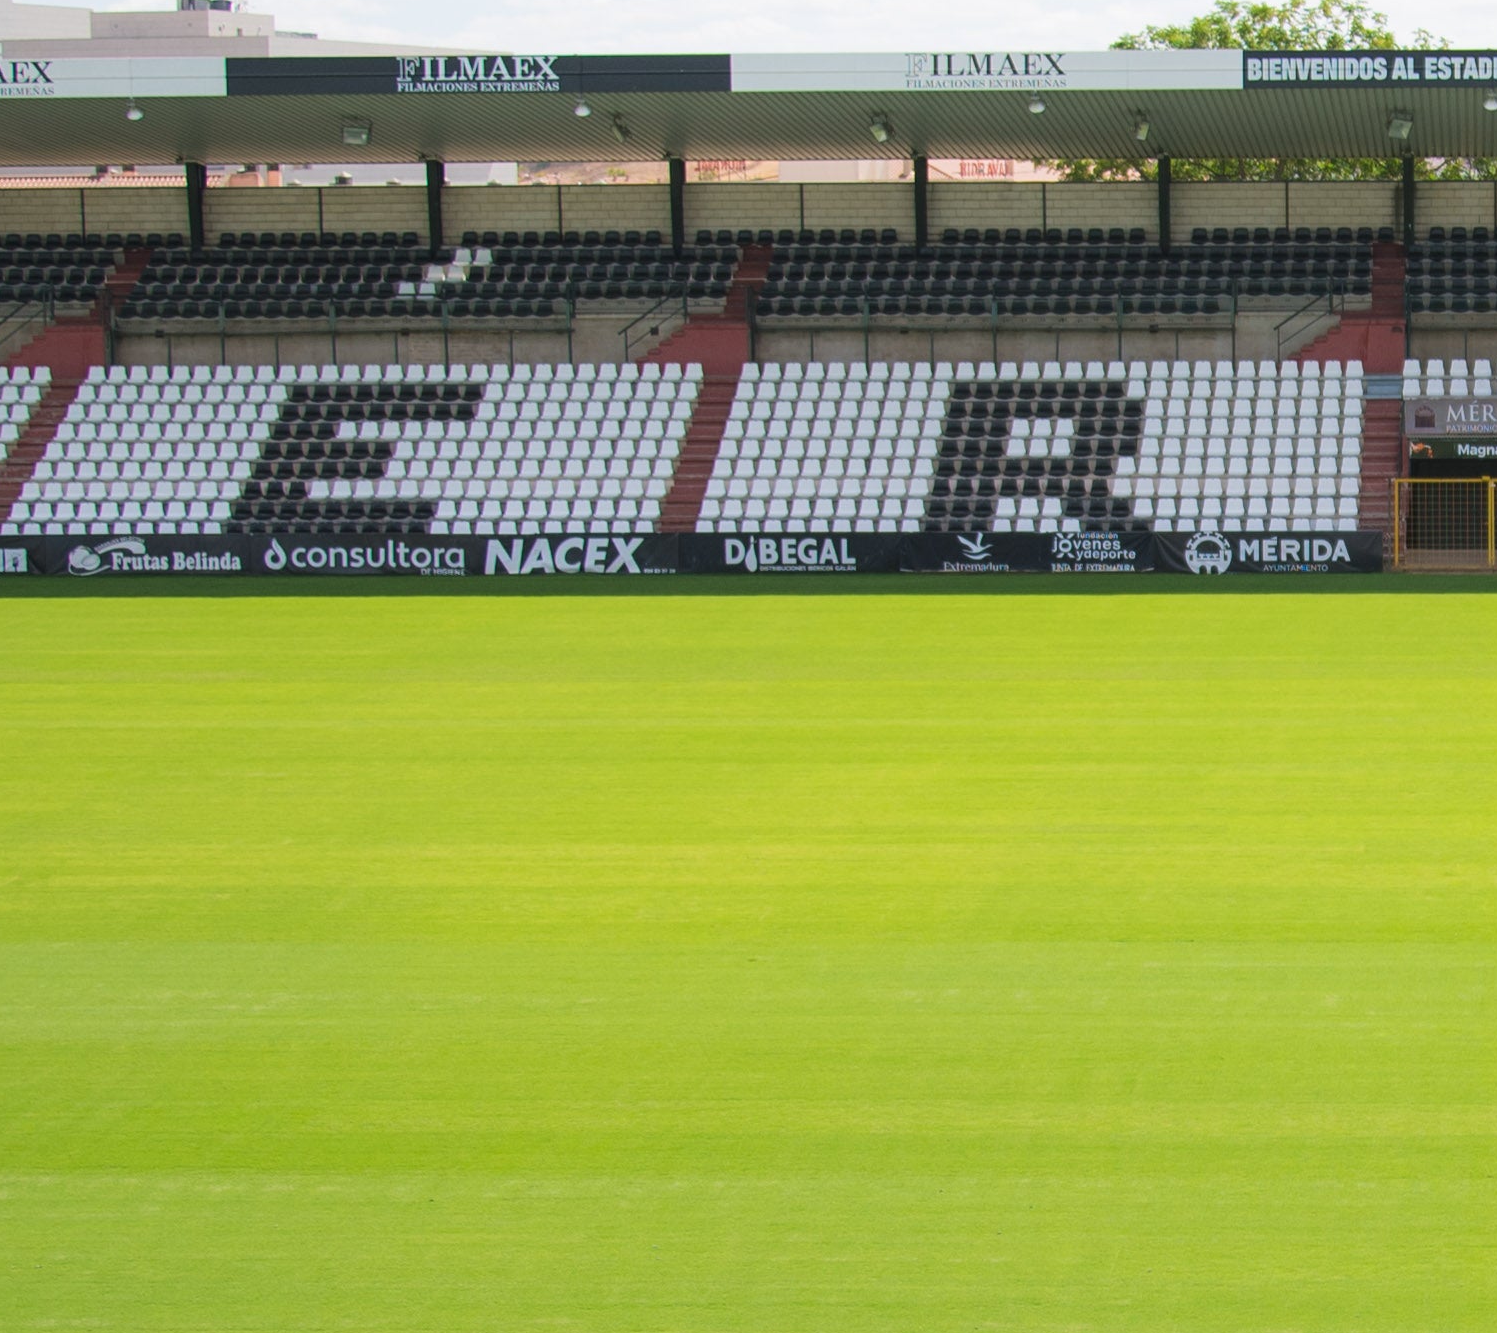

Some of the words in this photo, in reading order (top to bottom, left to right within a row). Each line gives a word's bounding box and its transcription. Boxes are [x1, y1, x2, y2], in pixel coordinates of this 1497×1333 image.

[397, 56, 559, 81] FILMAEX
[904, 53, 1066, 78] FILMAEX
[1248, 56, 1387, 81] BIENVENIDOS
[1392, 57, 1420, 80] AL
[397, 82, 477, 92] FILMACIONES
[481, 79, 559, 92] EXTREMEÑAS
[905, 79, 985, 89] FILMACIONES
[989, 77, 1067, 88] EXTREMEÑAS
[291, 538, 465, 569] consultora
[484, 537, 644, 575] NACEX
[1076, 548, 1137, 561] ydeporte
[1239, 536, 1350, 562] MÉRIDA
[111, 551, 169, 571] Frutas
[173, 551, 242, 571] Belinda
[943, 561, 1010, 572] Extremadura
[1263, 564, 1329, 572] AYUNTAMIENTO
